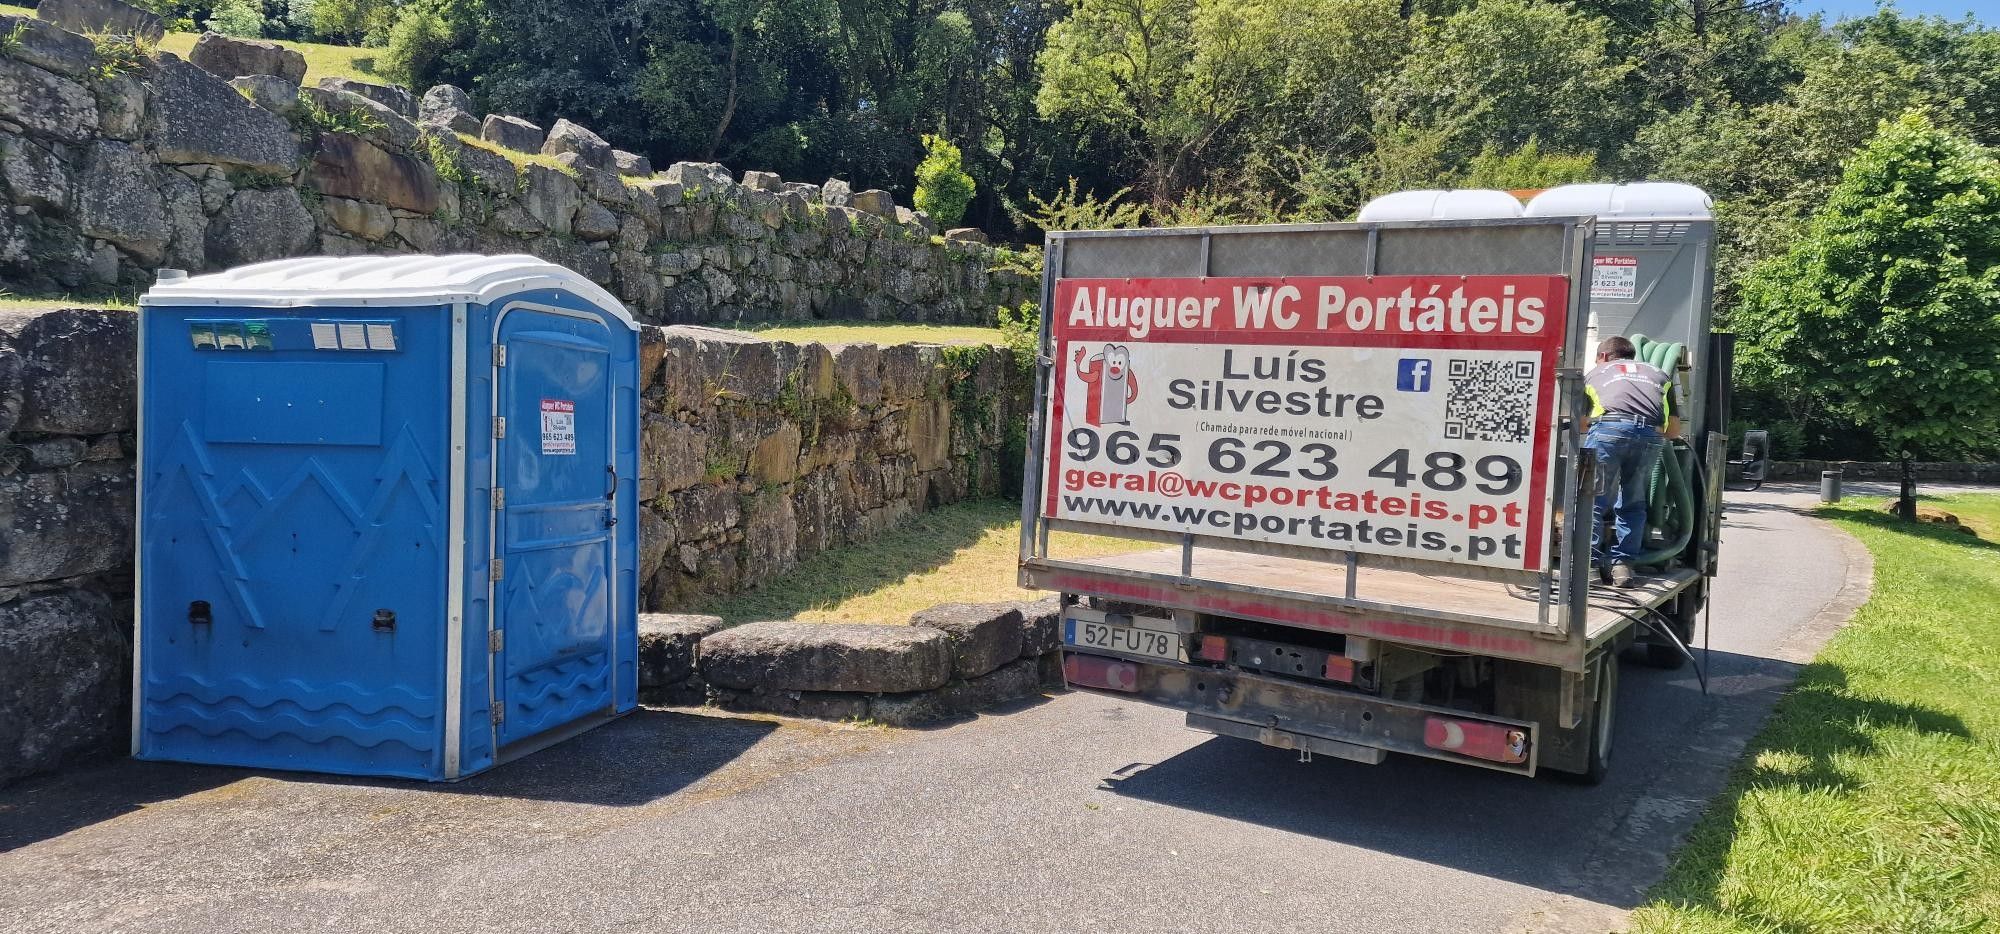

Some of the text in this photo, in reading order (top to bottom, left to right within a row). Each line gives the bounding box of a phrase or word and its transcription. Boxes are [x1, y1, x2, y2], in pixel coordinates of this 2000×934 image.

[1618, 280, 1634, 288] 489
[1068, 284, 1545, 339] Aluguer WC Portáteis
[1223, 349, 1327, 383] Luís
[1166, 378, 1385, 420] Silvestre
[1239, 425, 1258, 436] para
[1260, 425, 1279, 436] rede
[1280, 426, 1307, 438] móvel
[1308, 429, 1347, 440] nacional
[1067, 428, 1523, 496] 965 623 489
[1065, 469, 1522, 530] geral@wcportateis.pt
[1063, 495, 1521, 561] www.wcportateis.pt
[1085, 623, 1169, 655] 52FU78
